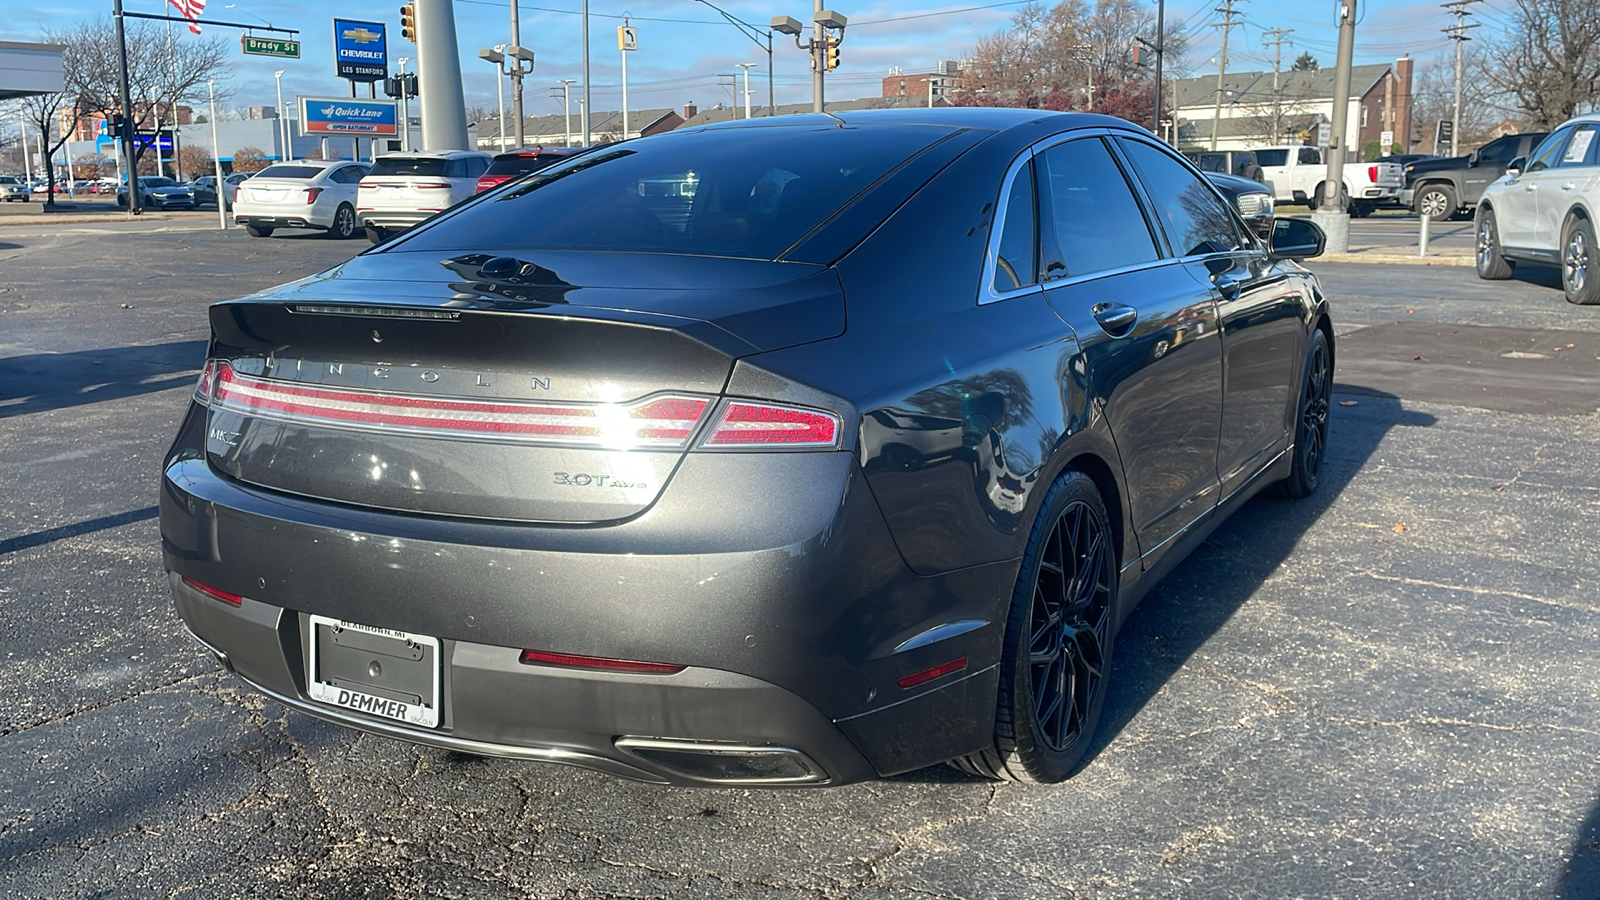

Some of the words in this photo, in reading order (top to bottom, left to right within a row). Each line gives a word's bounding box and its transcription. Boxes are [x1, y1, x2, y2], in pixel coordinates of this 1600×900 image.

[250, 40, 279, 51] Brady
[284, 43, 295, 51] St
[340, 49, 383, 59] CHEVROLET
[356, 67, 384, 75] STANFORD
[335, 107, 360, 117] Quick
[360, 109, 383, 117] Lane
[265, 356, 550, 390] LINCOLN
[210, 428, 242, 446] MKZ
[610, 480, 647, 489] AWD
[337, 690, 408, 720] DEMMER
